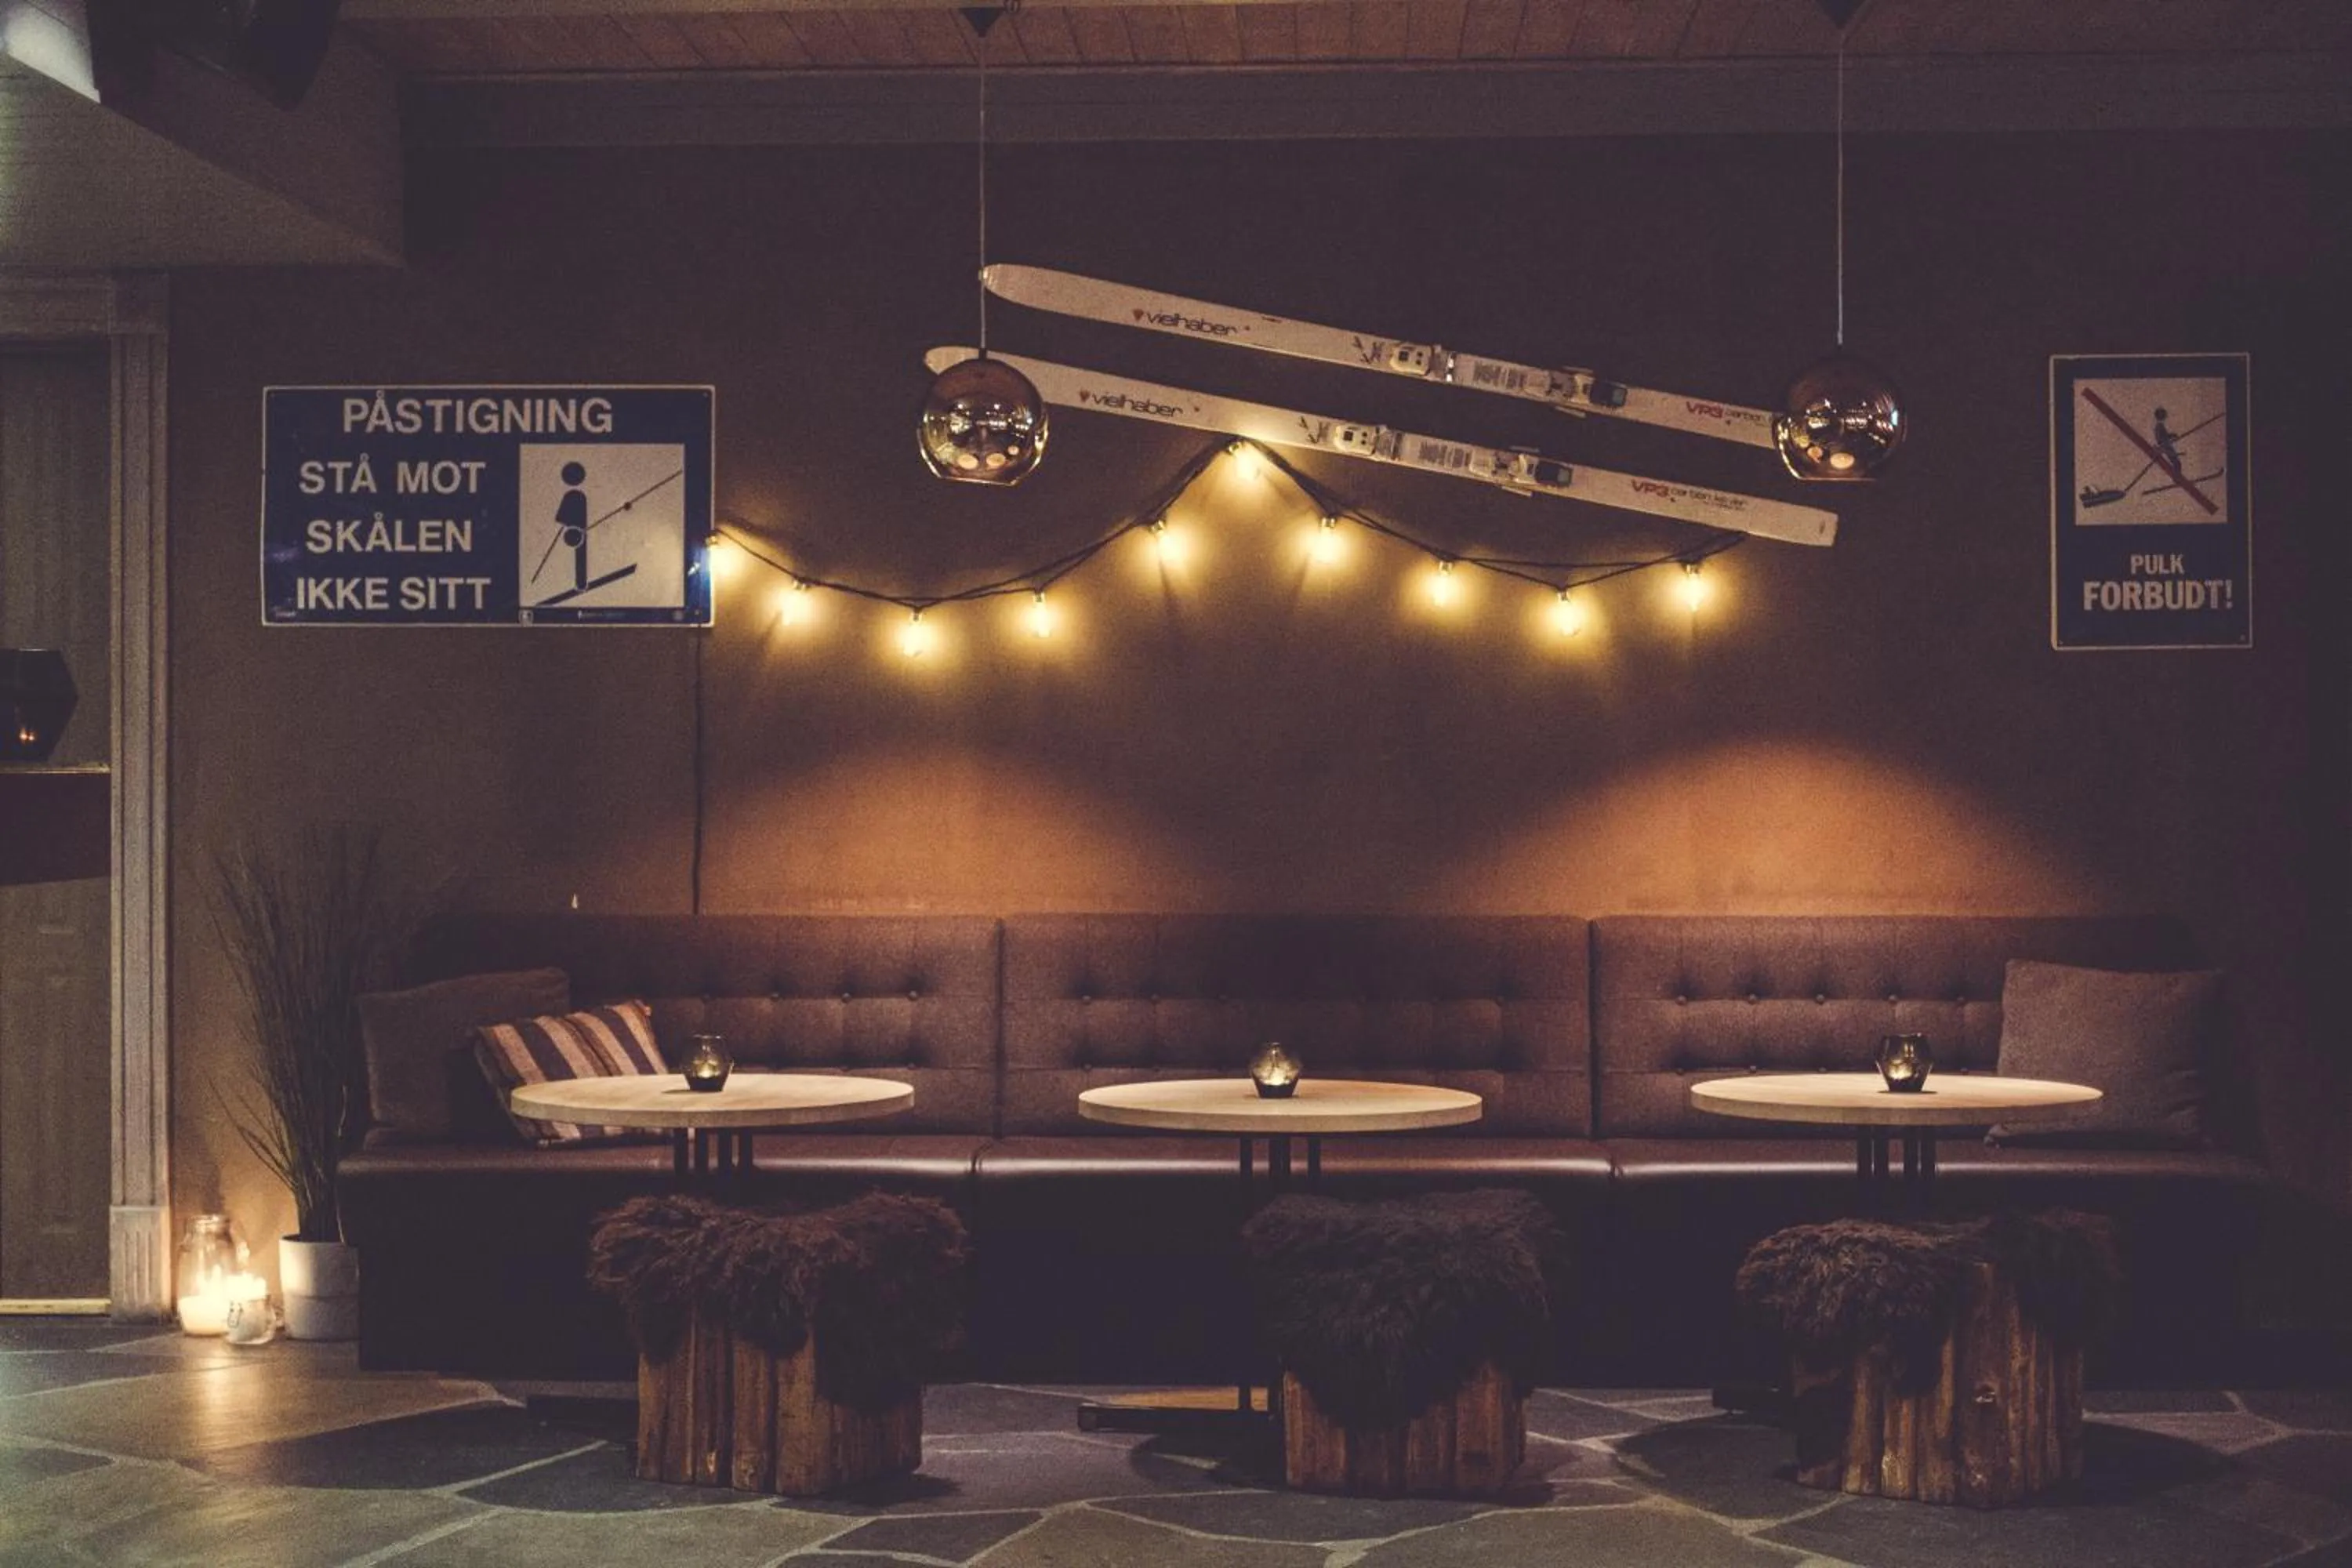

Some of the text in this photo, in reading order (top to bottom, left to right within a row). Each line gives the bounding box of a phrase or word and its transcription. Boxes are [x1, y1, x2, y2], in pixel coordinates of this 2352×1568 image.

[1146, 310, 1238, 336] vielhaber
[343, 390, 613, 434] PÅSTIGNING
[1092, 392, 1183, 417] vielhaber
[299, 453, 485, 494] STÅ MOT
[306, 512, 472, 553] SKÅLEN
[2130, 554, 2185, 575] PULK
[296, 577, 491, 611] IKKE SITT
[2083, 579, 2233, 610] FORBUDT!
